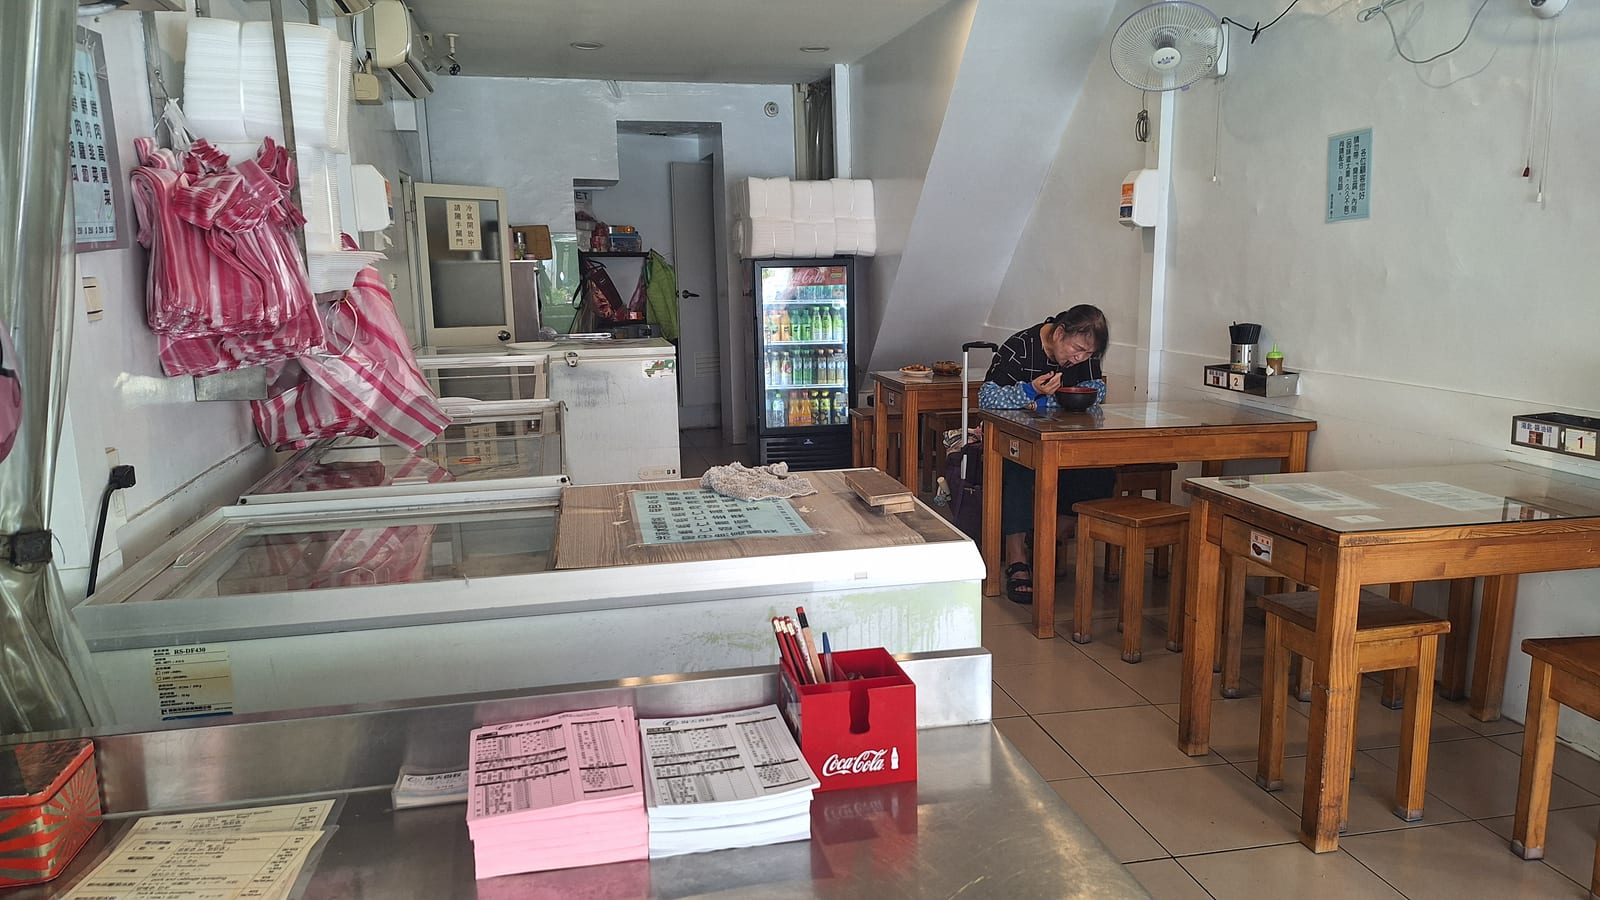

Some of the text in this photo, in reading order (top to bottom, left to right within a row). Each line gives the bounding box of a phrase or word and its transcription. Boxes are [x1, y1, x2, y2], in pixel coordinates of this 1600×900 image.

[453, 204, 464, 247] 請隨手關門
[465, 204, 475, 247] 冷氣開放中
[1233, 377, 1239, 387] 2
[1577, 436, 1584, 449] 1
[174, 647, 206, 655] RS-DF430
[822, 749, 888, 777] Coca-Cola
